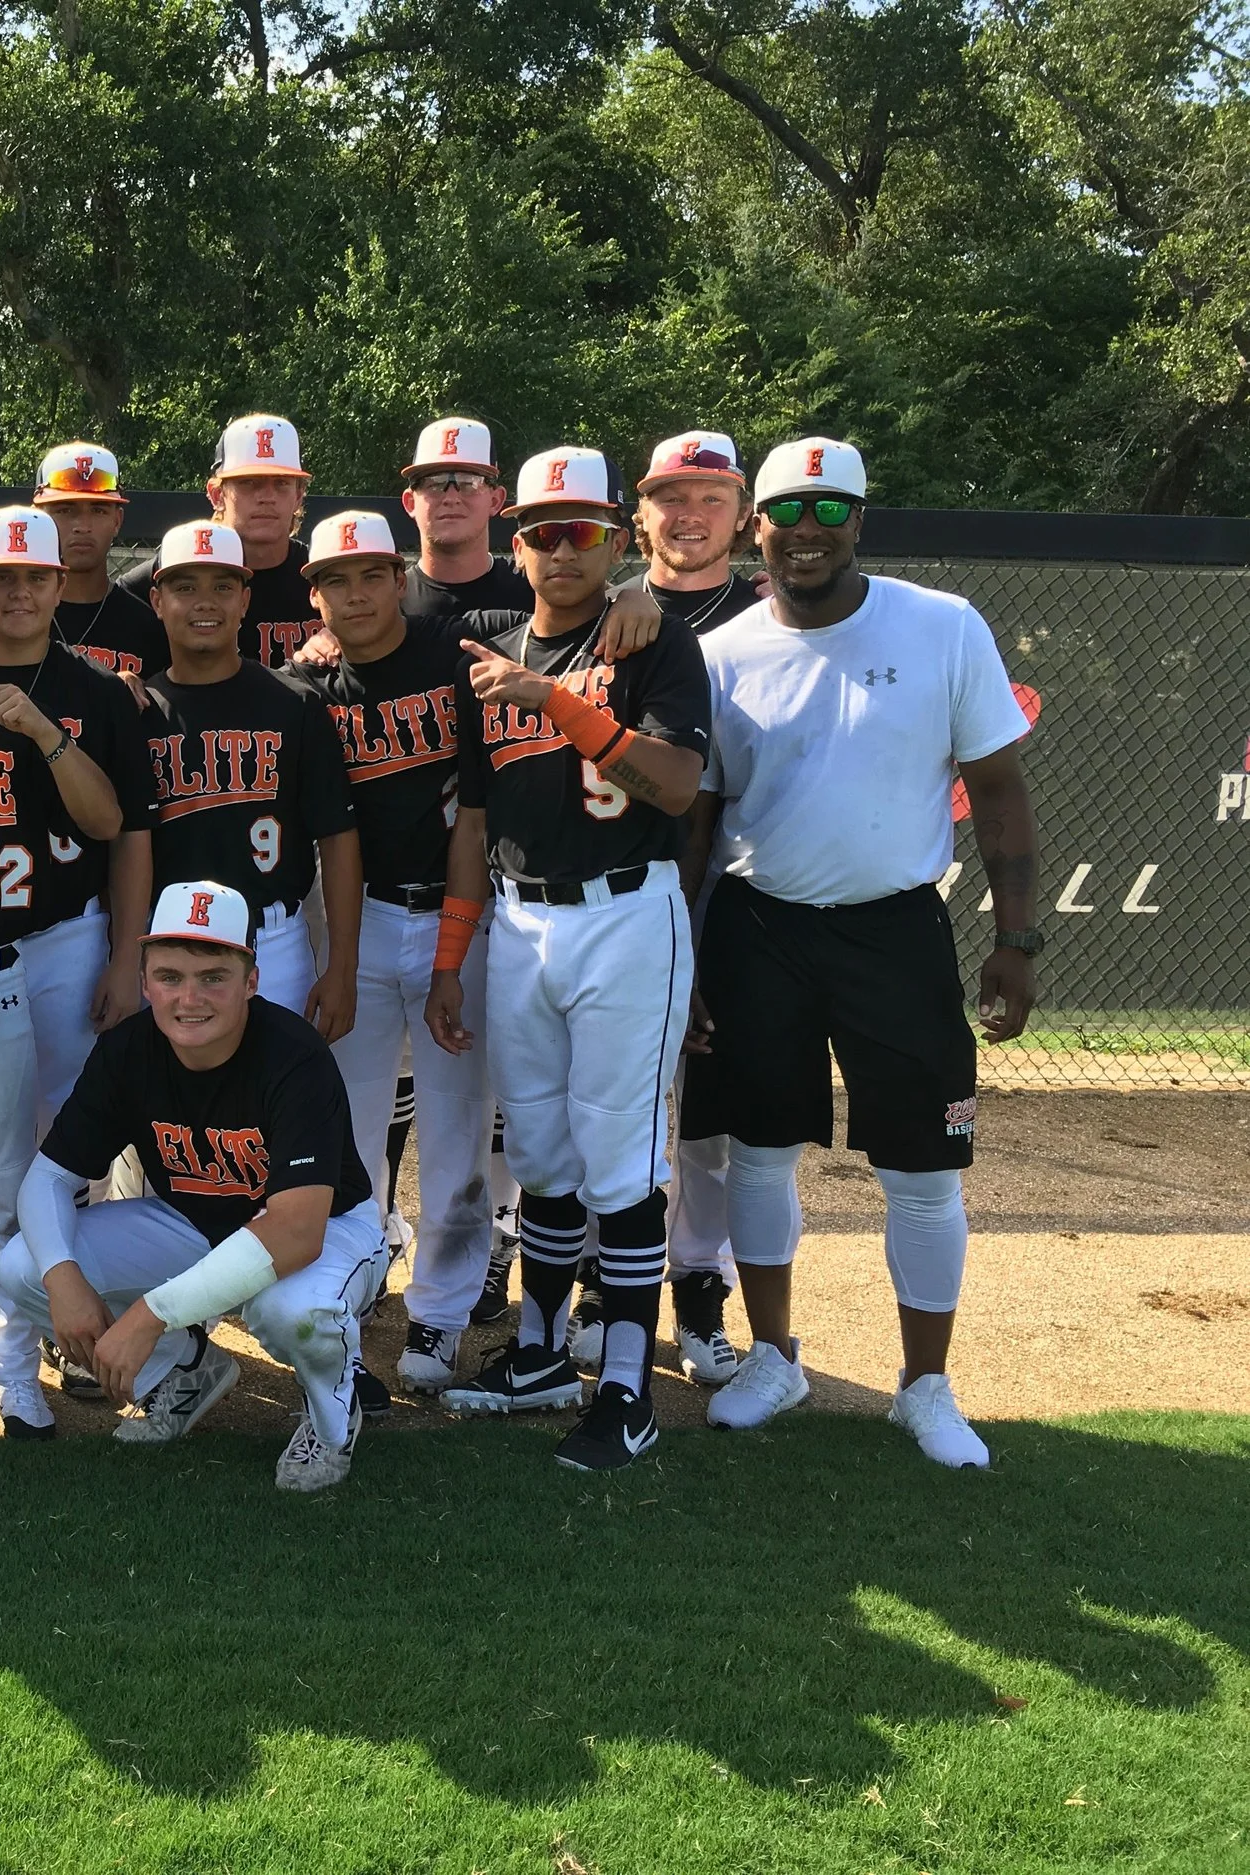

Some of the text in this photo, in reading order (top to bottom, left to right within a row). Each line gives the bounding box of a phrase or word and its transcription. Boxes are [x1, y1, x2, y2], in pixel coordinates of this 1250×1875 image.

[255, 429, 275, 458] E
[439, 427, 460, 455] E
[544, 459, 568, 492] E
[806, 448, 823, 477] E
[7, 521, 28, 552] E
[193, 529, 213, 555] E
[337, 522, 357, 551] E
[326, 685, 458, 762] ELITE
[147, 730, 282, 799] ELITE
[250, 815, 282, 874] 9
[187, 892, 214, 926] E
[151, 1120, 270, 1184] ELITE
[289, 1156, 315, 1166] marucci
